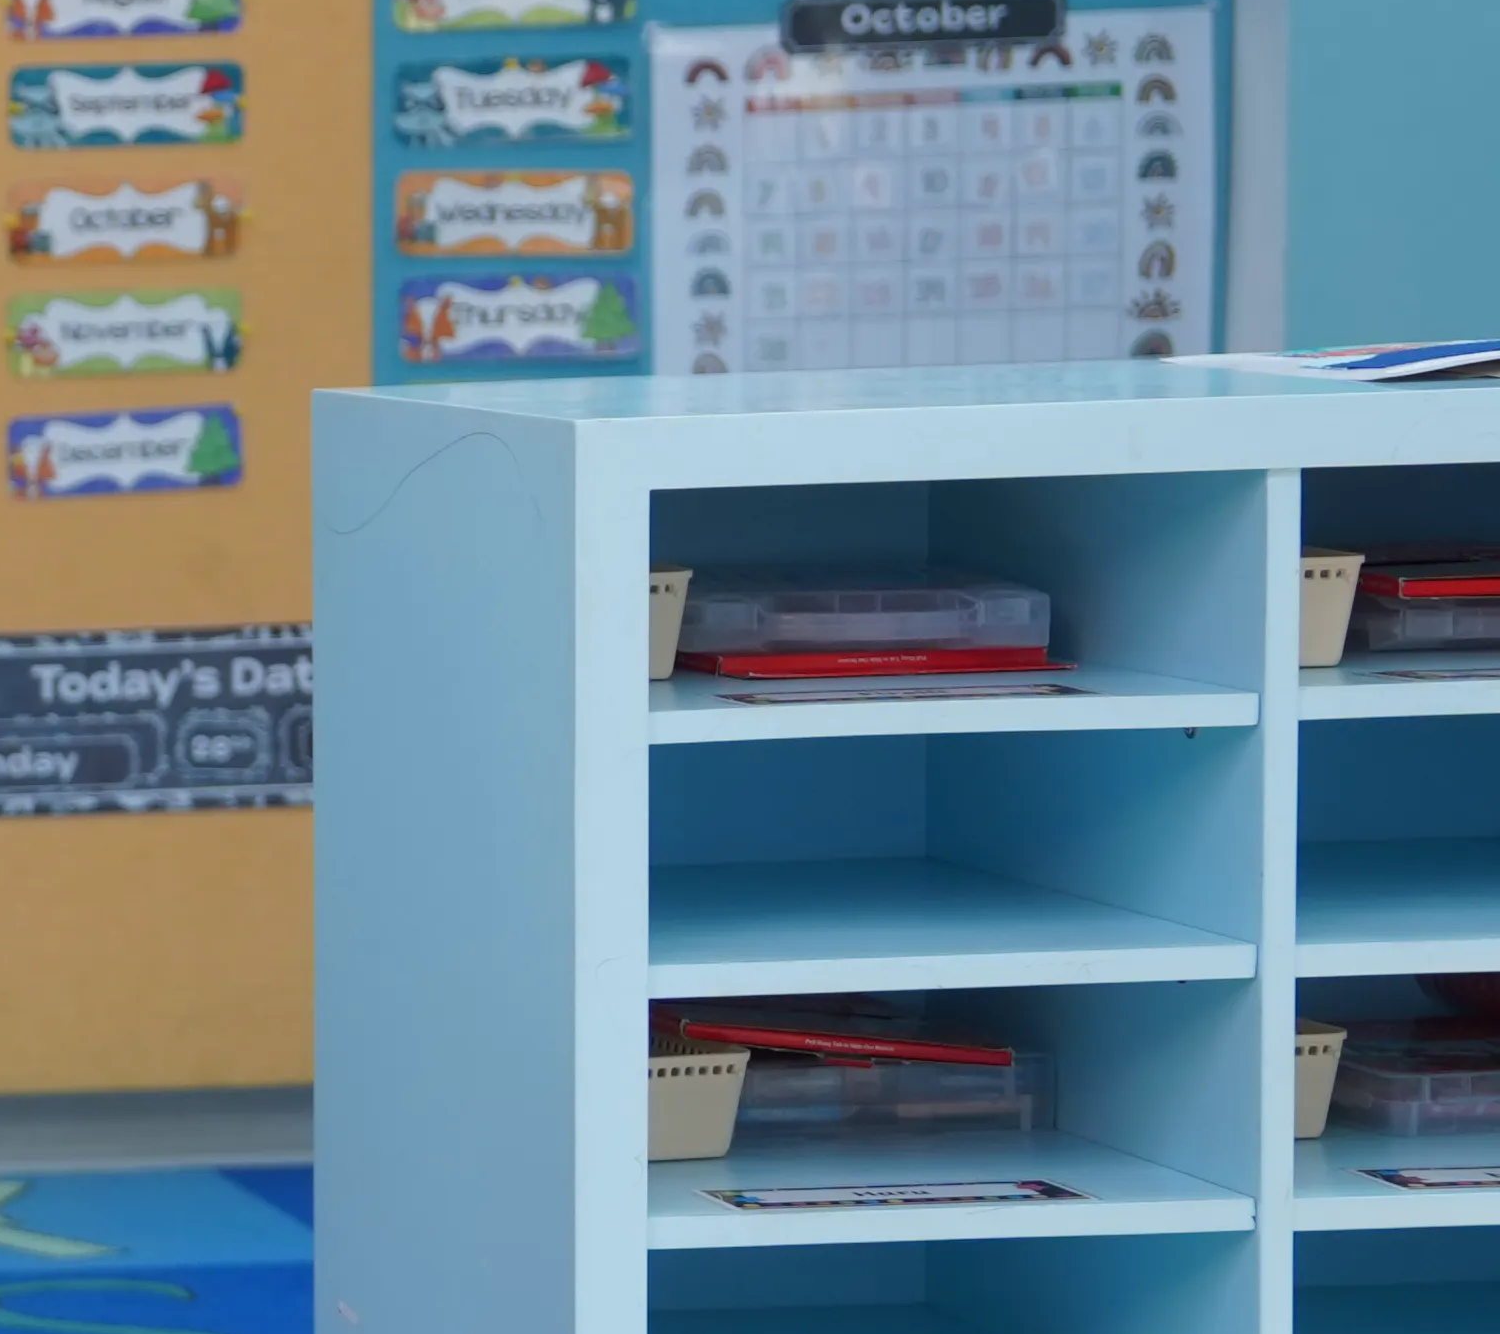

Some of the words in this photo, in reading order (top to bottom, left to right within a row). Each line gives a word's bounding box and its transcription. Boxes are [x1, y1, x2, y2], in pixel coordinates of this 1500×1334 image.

[840, 0, 1008, 36] October
[453, 85, 572, 112] Tuesday
[30, 655, 222, 708] Today's
[230, 654, 313, 697] Dat
